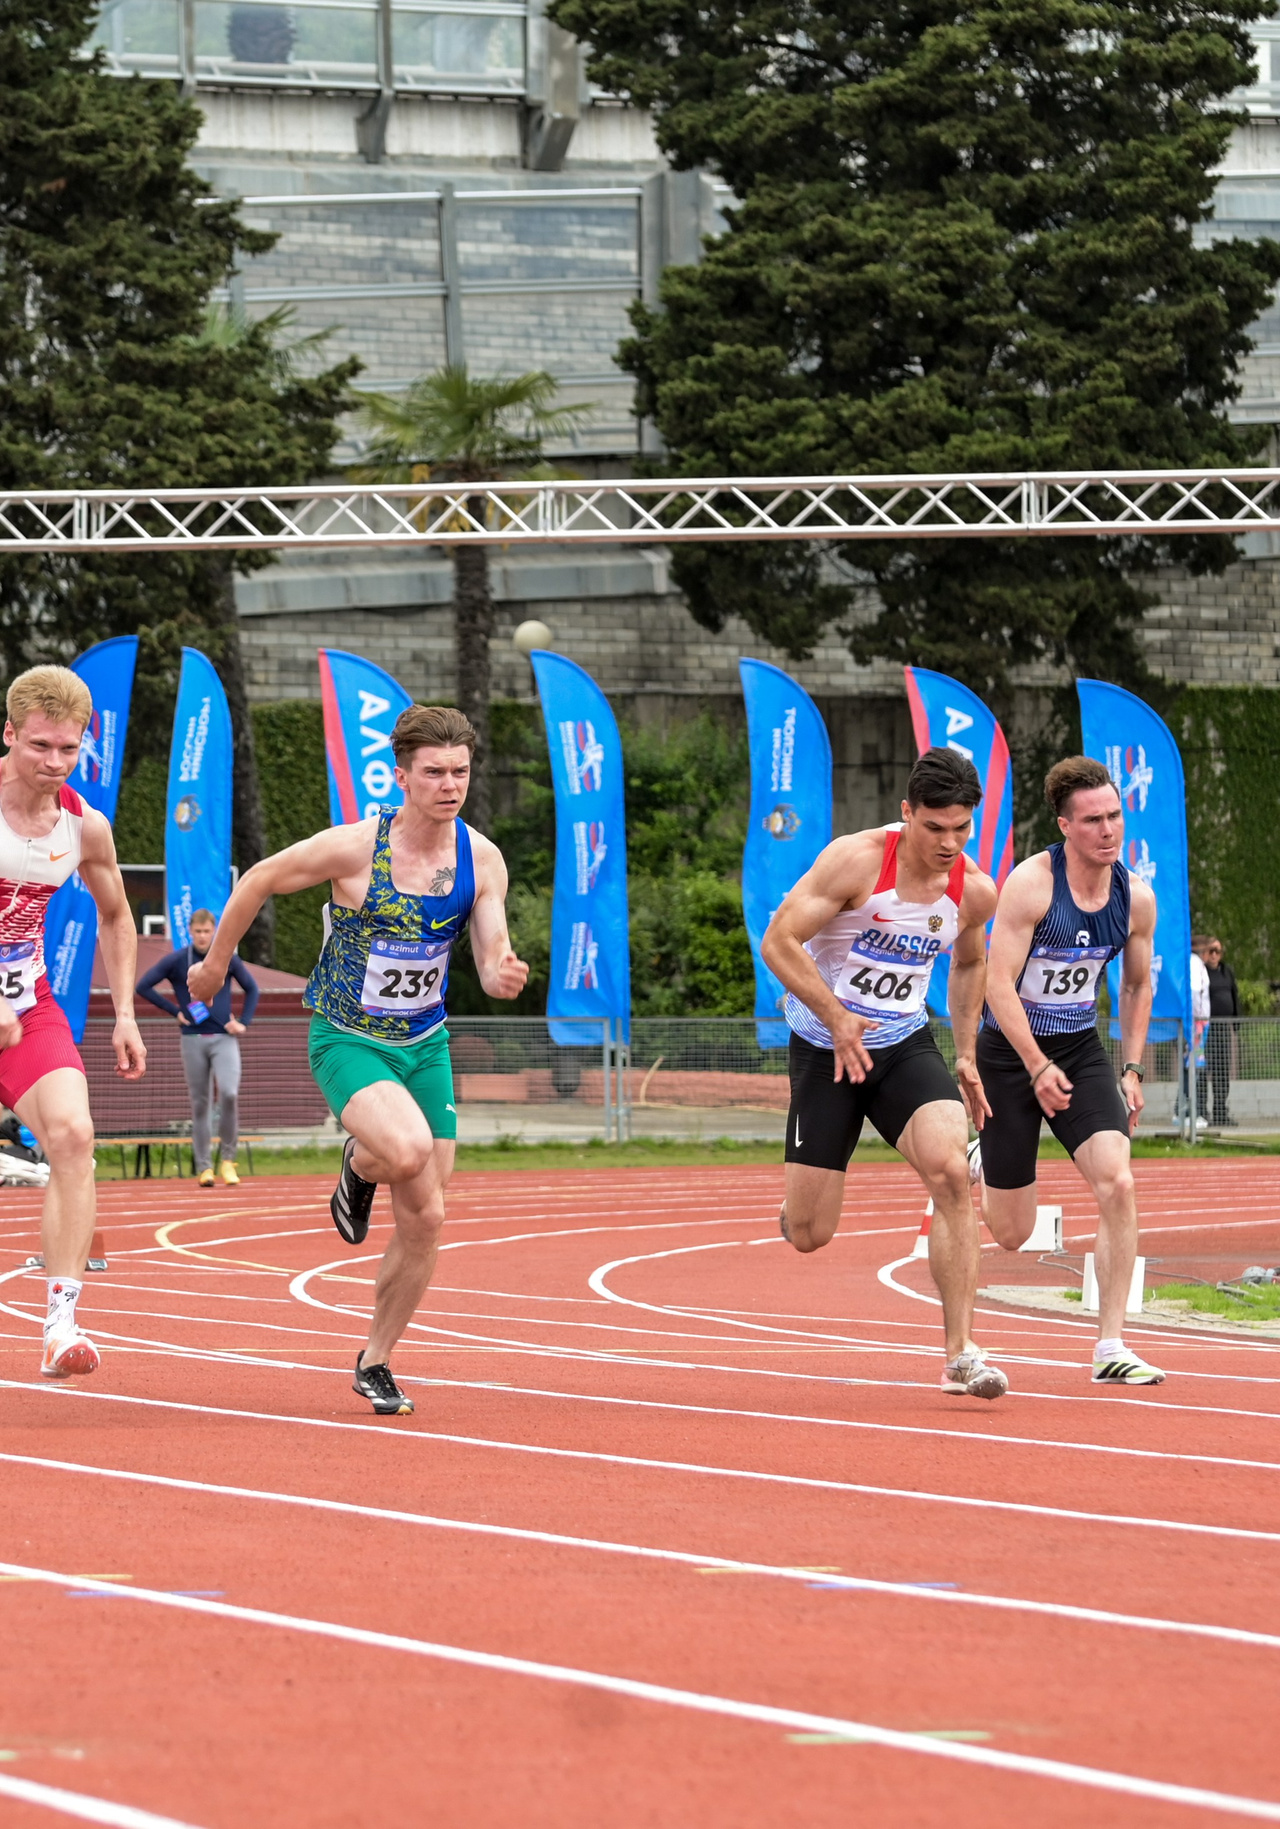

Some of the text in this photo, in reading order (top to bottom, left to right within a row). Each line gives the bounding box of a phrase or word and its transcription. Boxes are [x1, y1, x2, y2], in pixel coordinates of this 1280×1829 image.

[389, 944, 419, 954] azimut
[862, 929, 941, 953] RUSSIA
[379, 967, 439, 998] 239
[849, 967, 912, 1001] 406
[1042, 967, 1089, 995] 139
